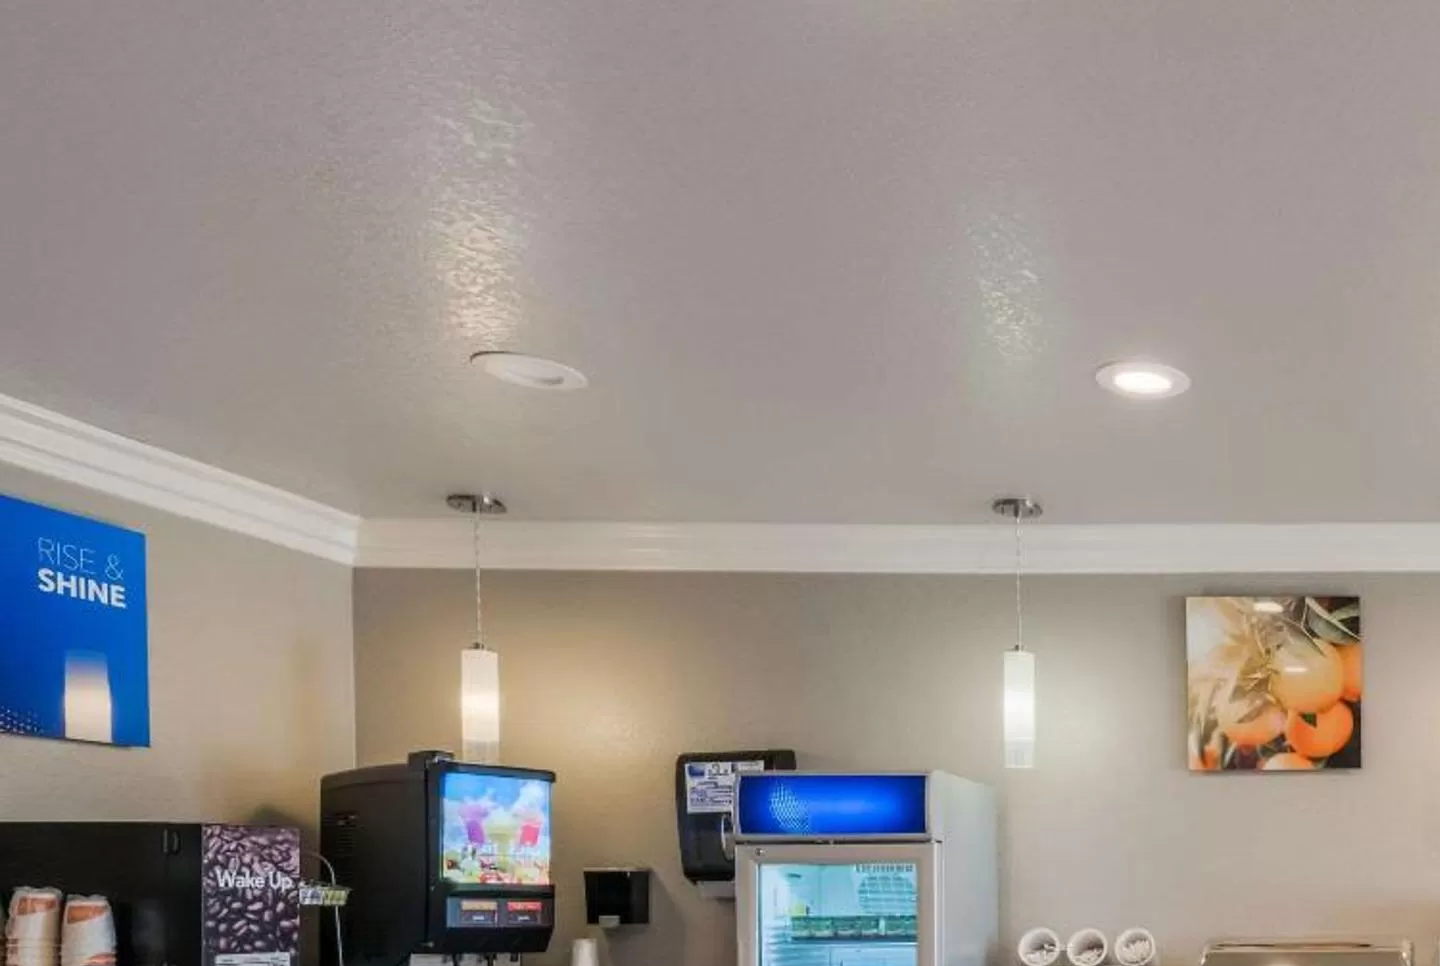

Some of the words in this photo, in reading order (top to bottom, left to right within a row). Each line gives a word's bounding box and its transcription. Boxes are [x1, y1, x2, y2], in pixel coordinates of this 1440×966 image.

[38, 537, 96, 575] RISE
[104, 553, 124, 581] &
[37, 568, 127, 608] SHINE
[214, 866, 266, 889] Wake
[268, 870, 293, 892] Up
